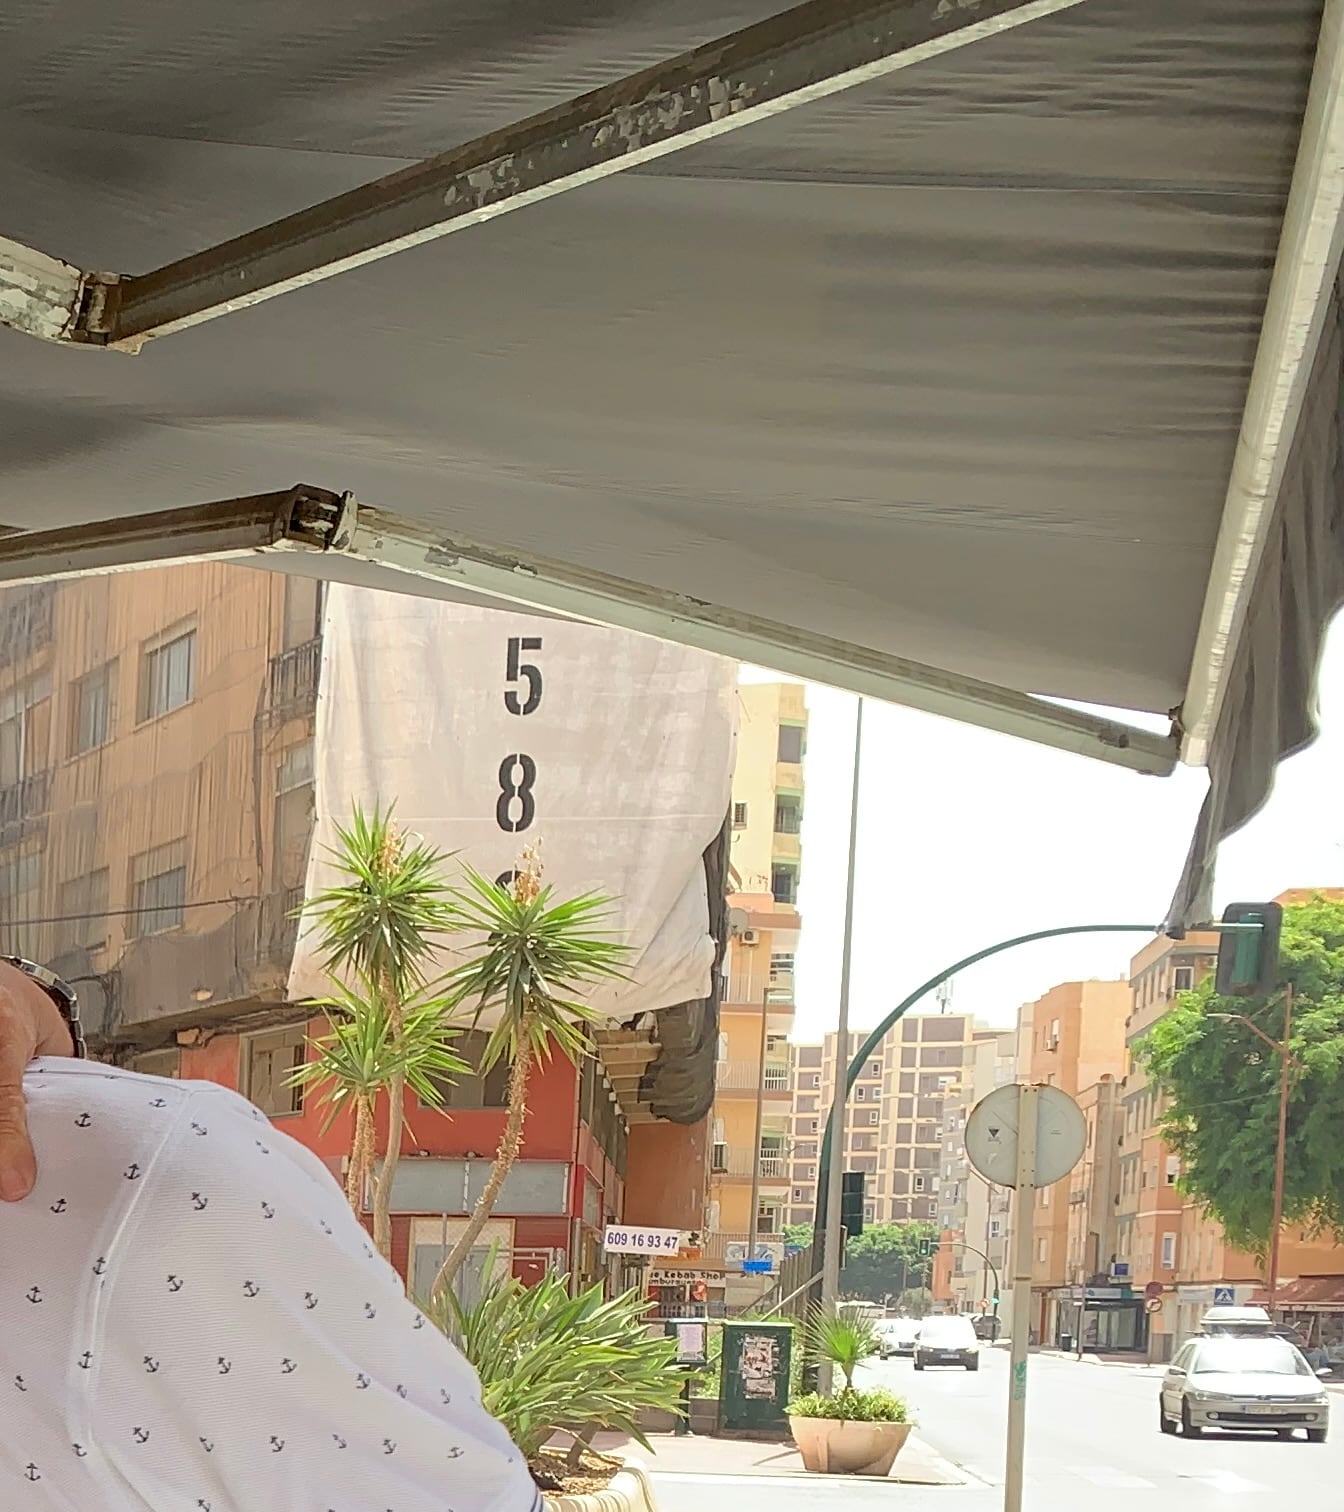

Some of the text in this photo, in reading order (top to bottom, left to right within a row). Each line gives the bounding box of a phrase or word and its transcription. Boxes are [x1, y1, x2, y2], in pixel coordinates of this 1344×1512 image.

[503, 636, 544, 717] 5
[495, 753, 537, 833] 8
[607, 1232, 678, 1250] 609 16 93 47
[664, 1270, 696, 1280] Kebab
